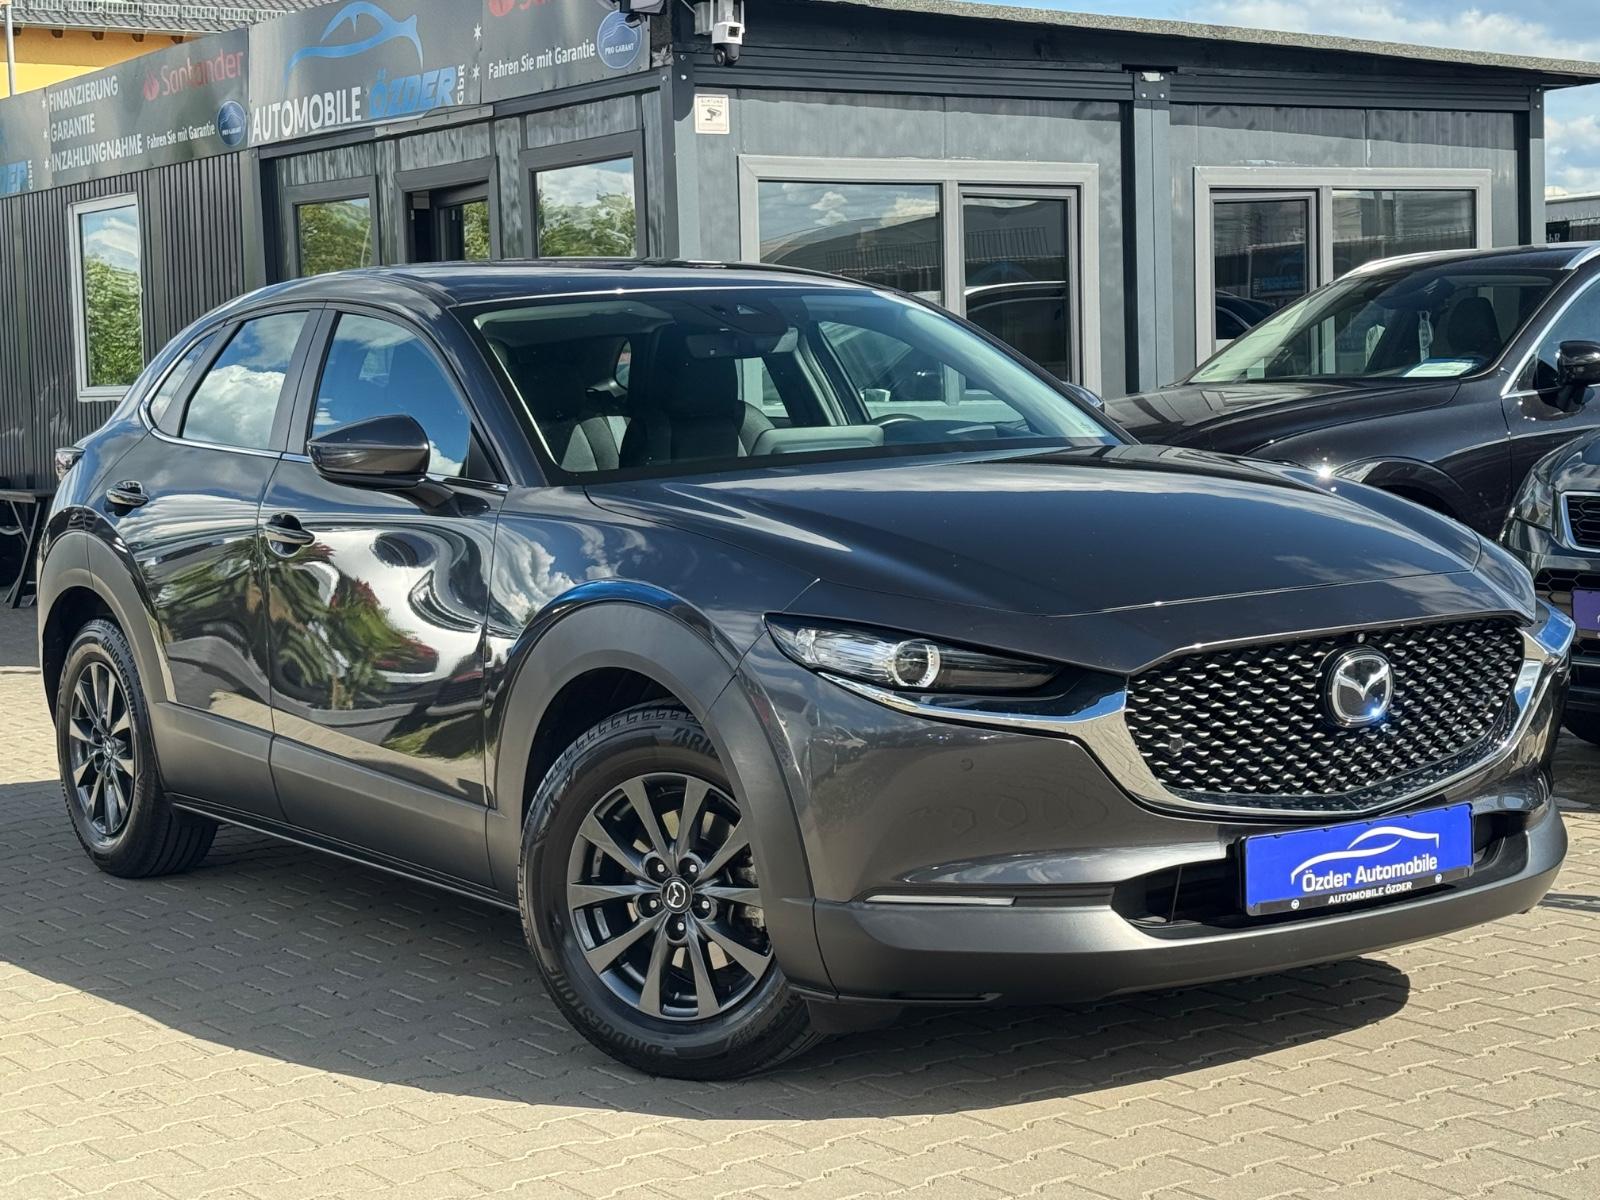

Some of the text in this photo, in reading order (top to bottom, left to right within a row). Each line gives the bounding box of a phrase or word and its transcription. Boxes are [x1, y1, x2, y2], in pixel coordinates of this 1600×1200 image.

[161, 47, 244, 96] Santander
[488, 39, 596, 79] Fahren Sie mit Garantie
[49, 75, 119, 112] FINANZIERUNG
[457, 64, 465, 105] GbR
[50, 113, 95, 142] GARANTIE
[252, 86, 362, 143] AUTOMOBILE
[51, 133, 143, 172] INZAHLUNGNAHME
[146, 133, 167, 150] Fahren
[167, 129, 176, 145] Sie
[177, 127, 188, 142] mit
[188, 120, 215, 140] Garantie
[1302, 853, 1437, 893] Özder Automobile
[1328, 887, 1384, 905] AUTOMOBILE
